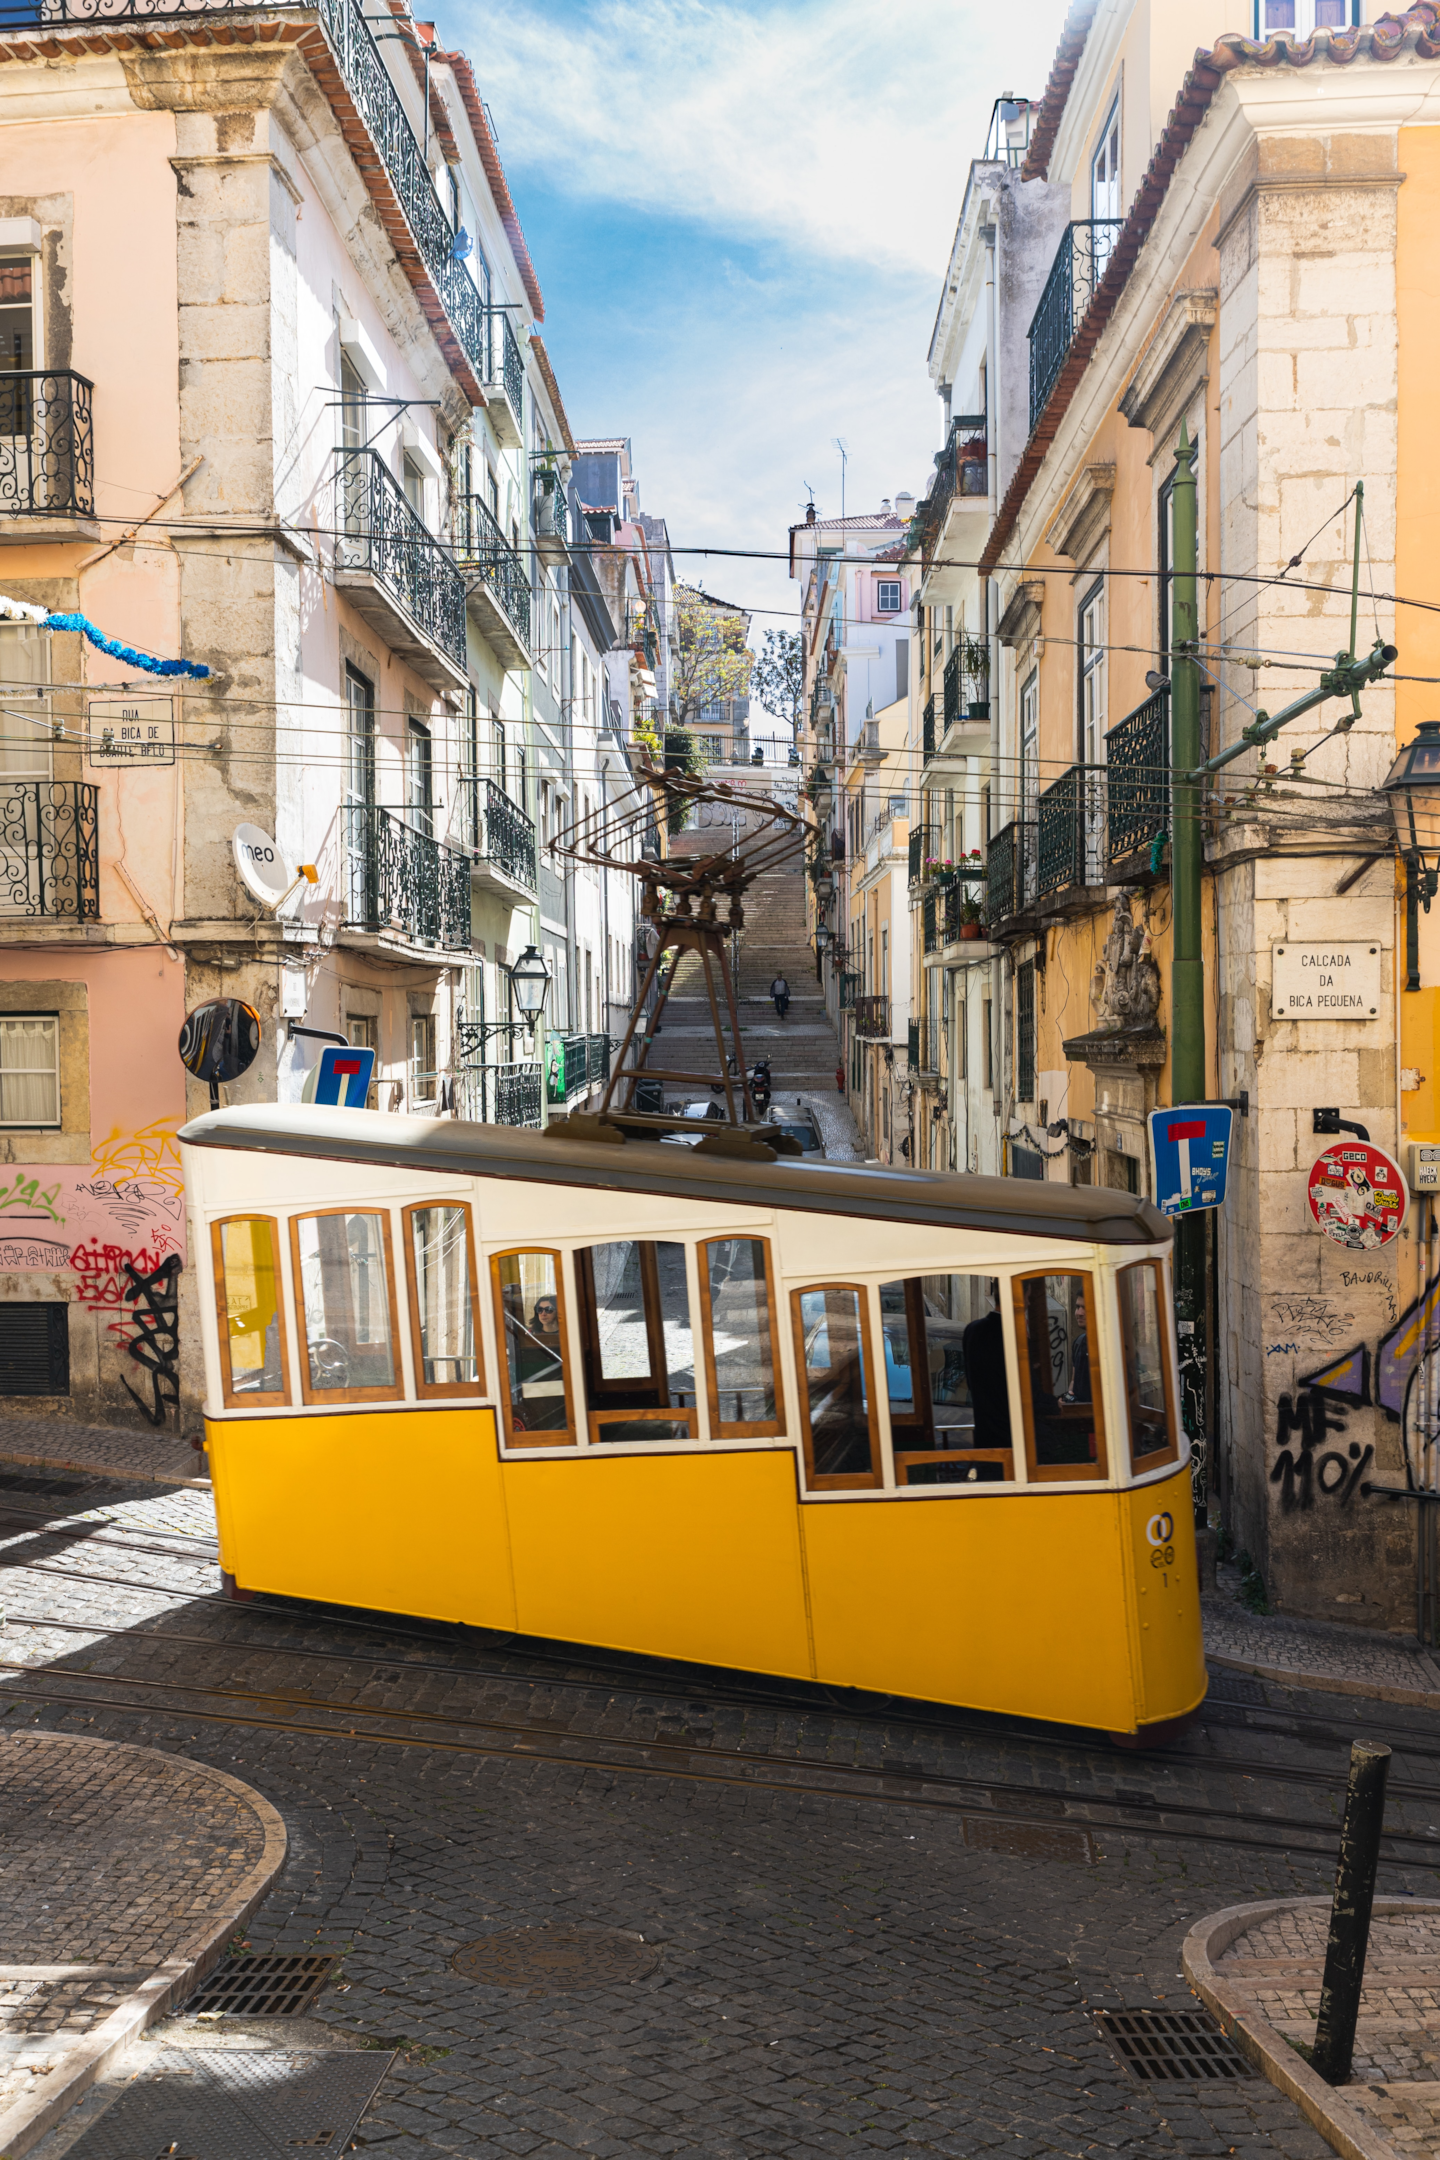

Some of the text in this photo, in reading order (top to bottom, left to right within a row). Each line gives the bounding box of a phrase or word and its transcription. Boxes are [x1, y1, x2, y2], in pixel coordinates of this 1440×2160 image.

[121, 727, 142, 740] BICA
[147, 726, 160, 739] DE
[241, 843, 275, 863] meo
[1319, 974, 1334, 987] DA
[1289, 994, 1364, 1007] BICA PEQUENA
